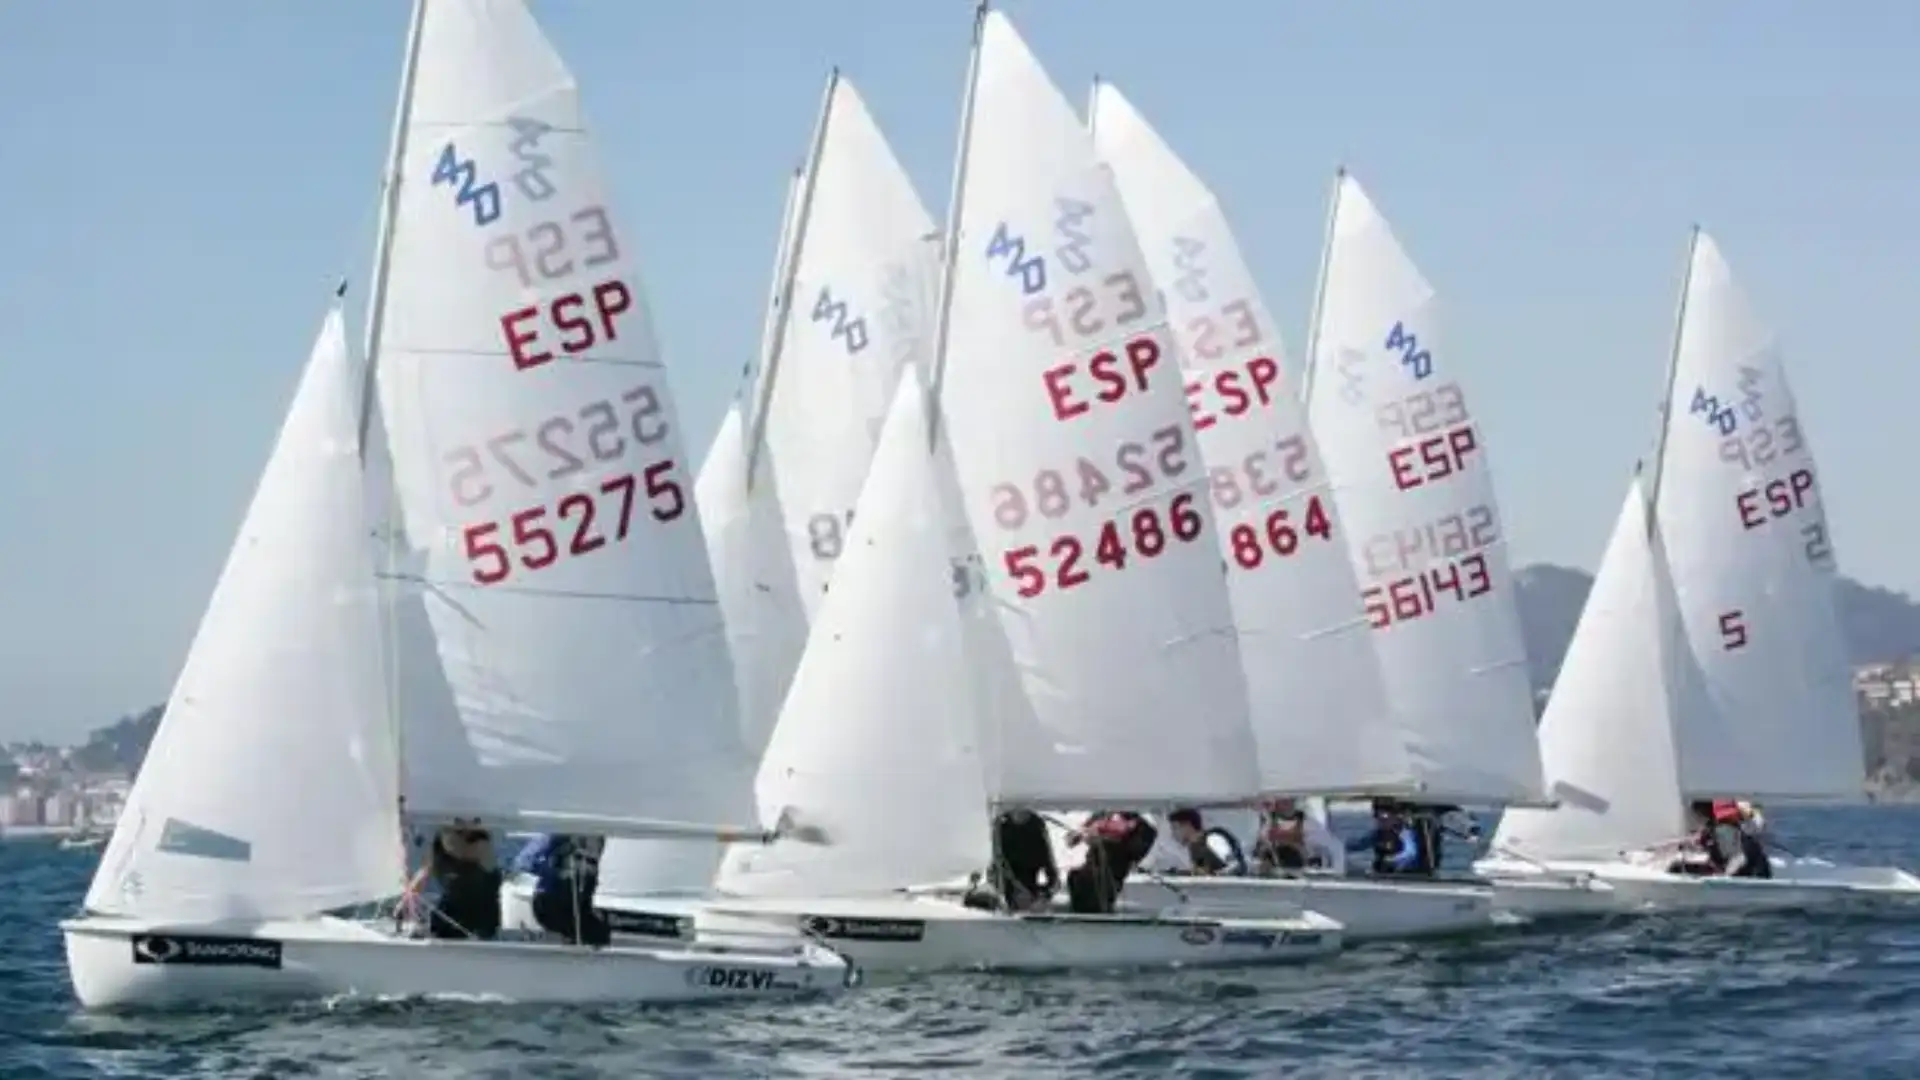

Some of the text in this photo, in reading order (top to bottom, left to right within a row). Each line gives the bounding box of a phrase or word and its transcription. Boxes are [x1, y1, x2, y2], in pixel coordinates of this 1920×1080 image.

[431, 142, 501, 226] 420
[986, 221, 1047, 294] 420
[501, 279, 632, 371] ESP
[812, 285, 869, 354] 420
[1386, 319, 1434, 380] 420
[1043, 338, 1162, 421] ESP
[1184, 357, 1279, 431] ESP
[1690, 384, 1738, 435] 420
[1390, 426, 1478, 490] ESP
[463, 459, 686, 585] 55275
[1231, 495, 1332, 570] 864
[1736, 469, 1813, 531] ESP
[1005, 491, 1203, 598] 52486
[1361, 552, 1491, 629] 56143
[1718, 609, 1748, 651] 5
